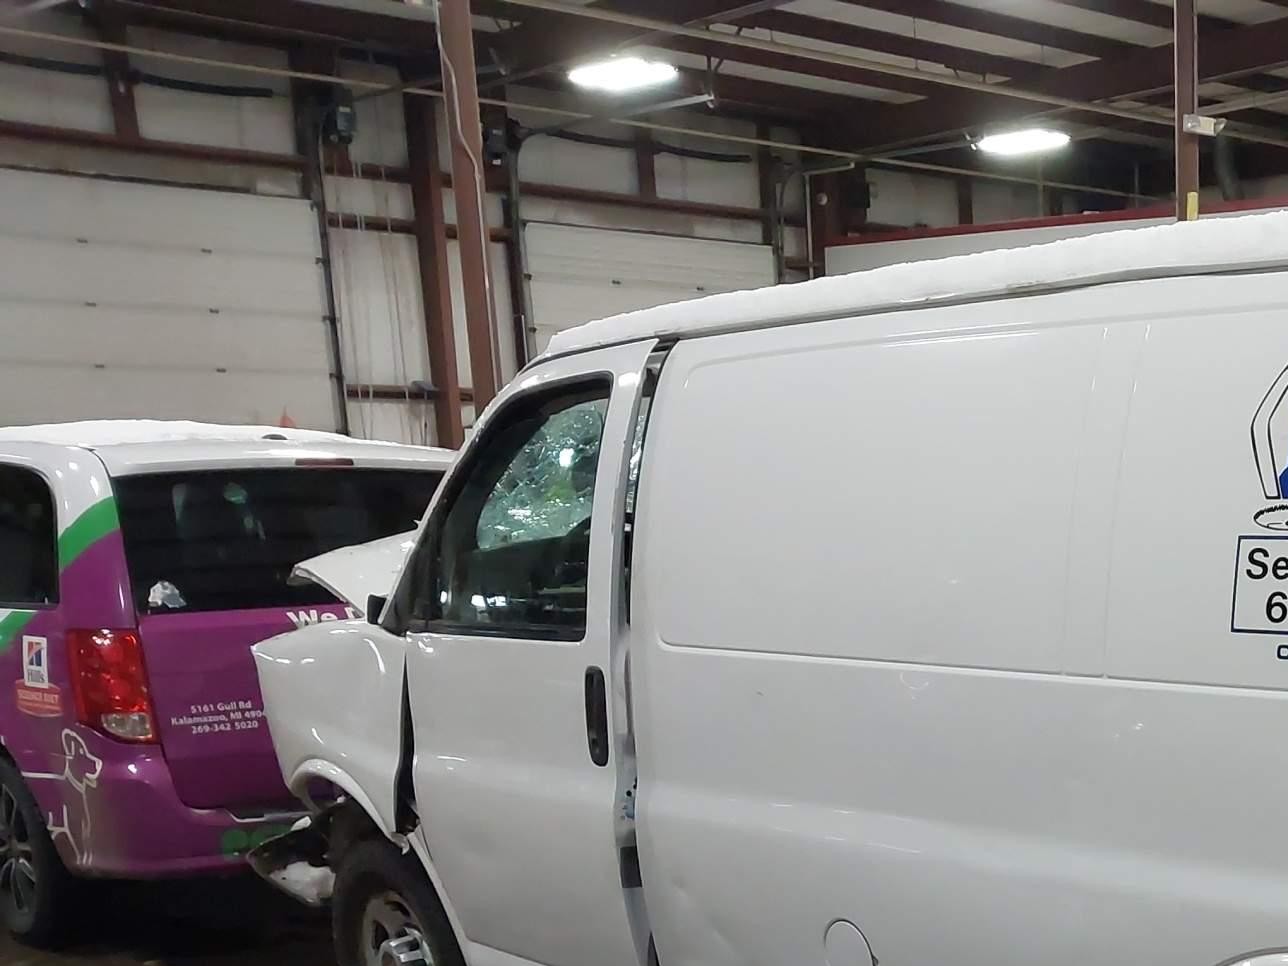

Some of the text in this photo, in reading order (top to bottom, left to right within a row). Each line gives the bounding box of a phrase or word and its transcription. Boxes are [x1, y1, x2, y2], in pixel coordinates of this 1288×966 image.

[190, 700, 252, 714] 5161 Gull Rd
[230, 711, 242, 720] MI
[192, 720, 259, 734] 269-342 5020
